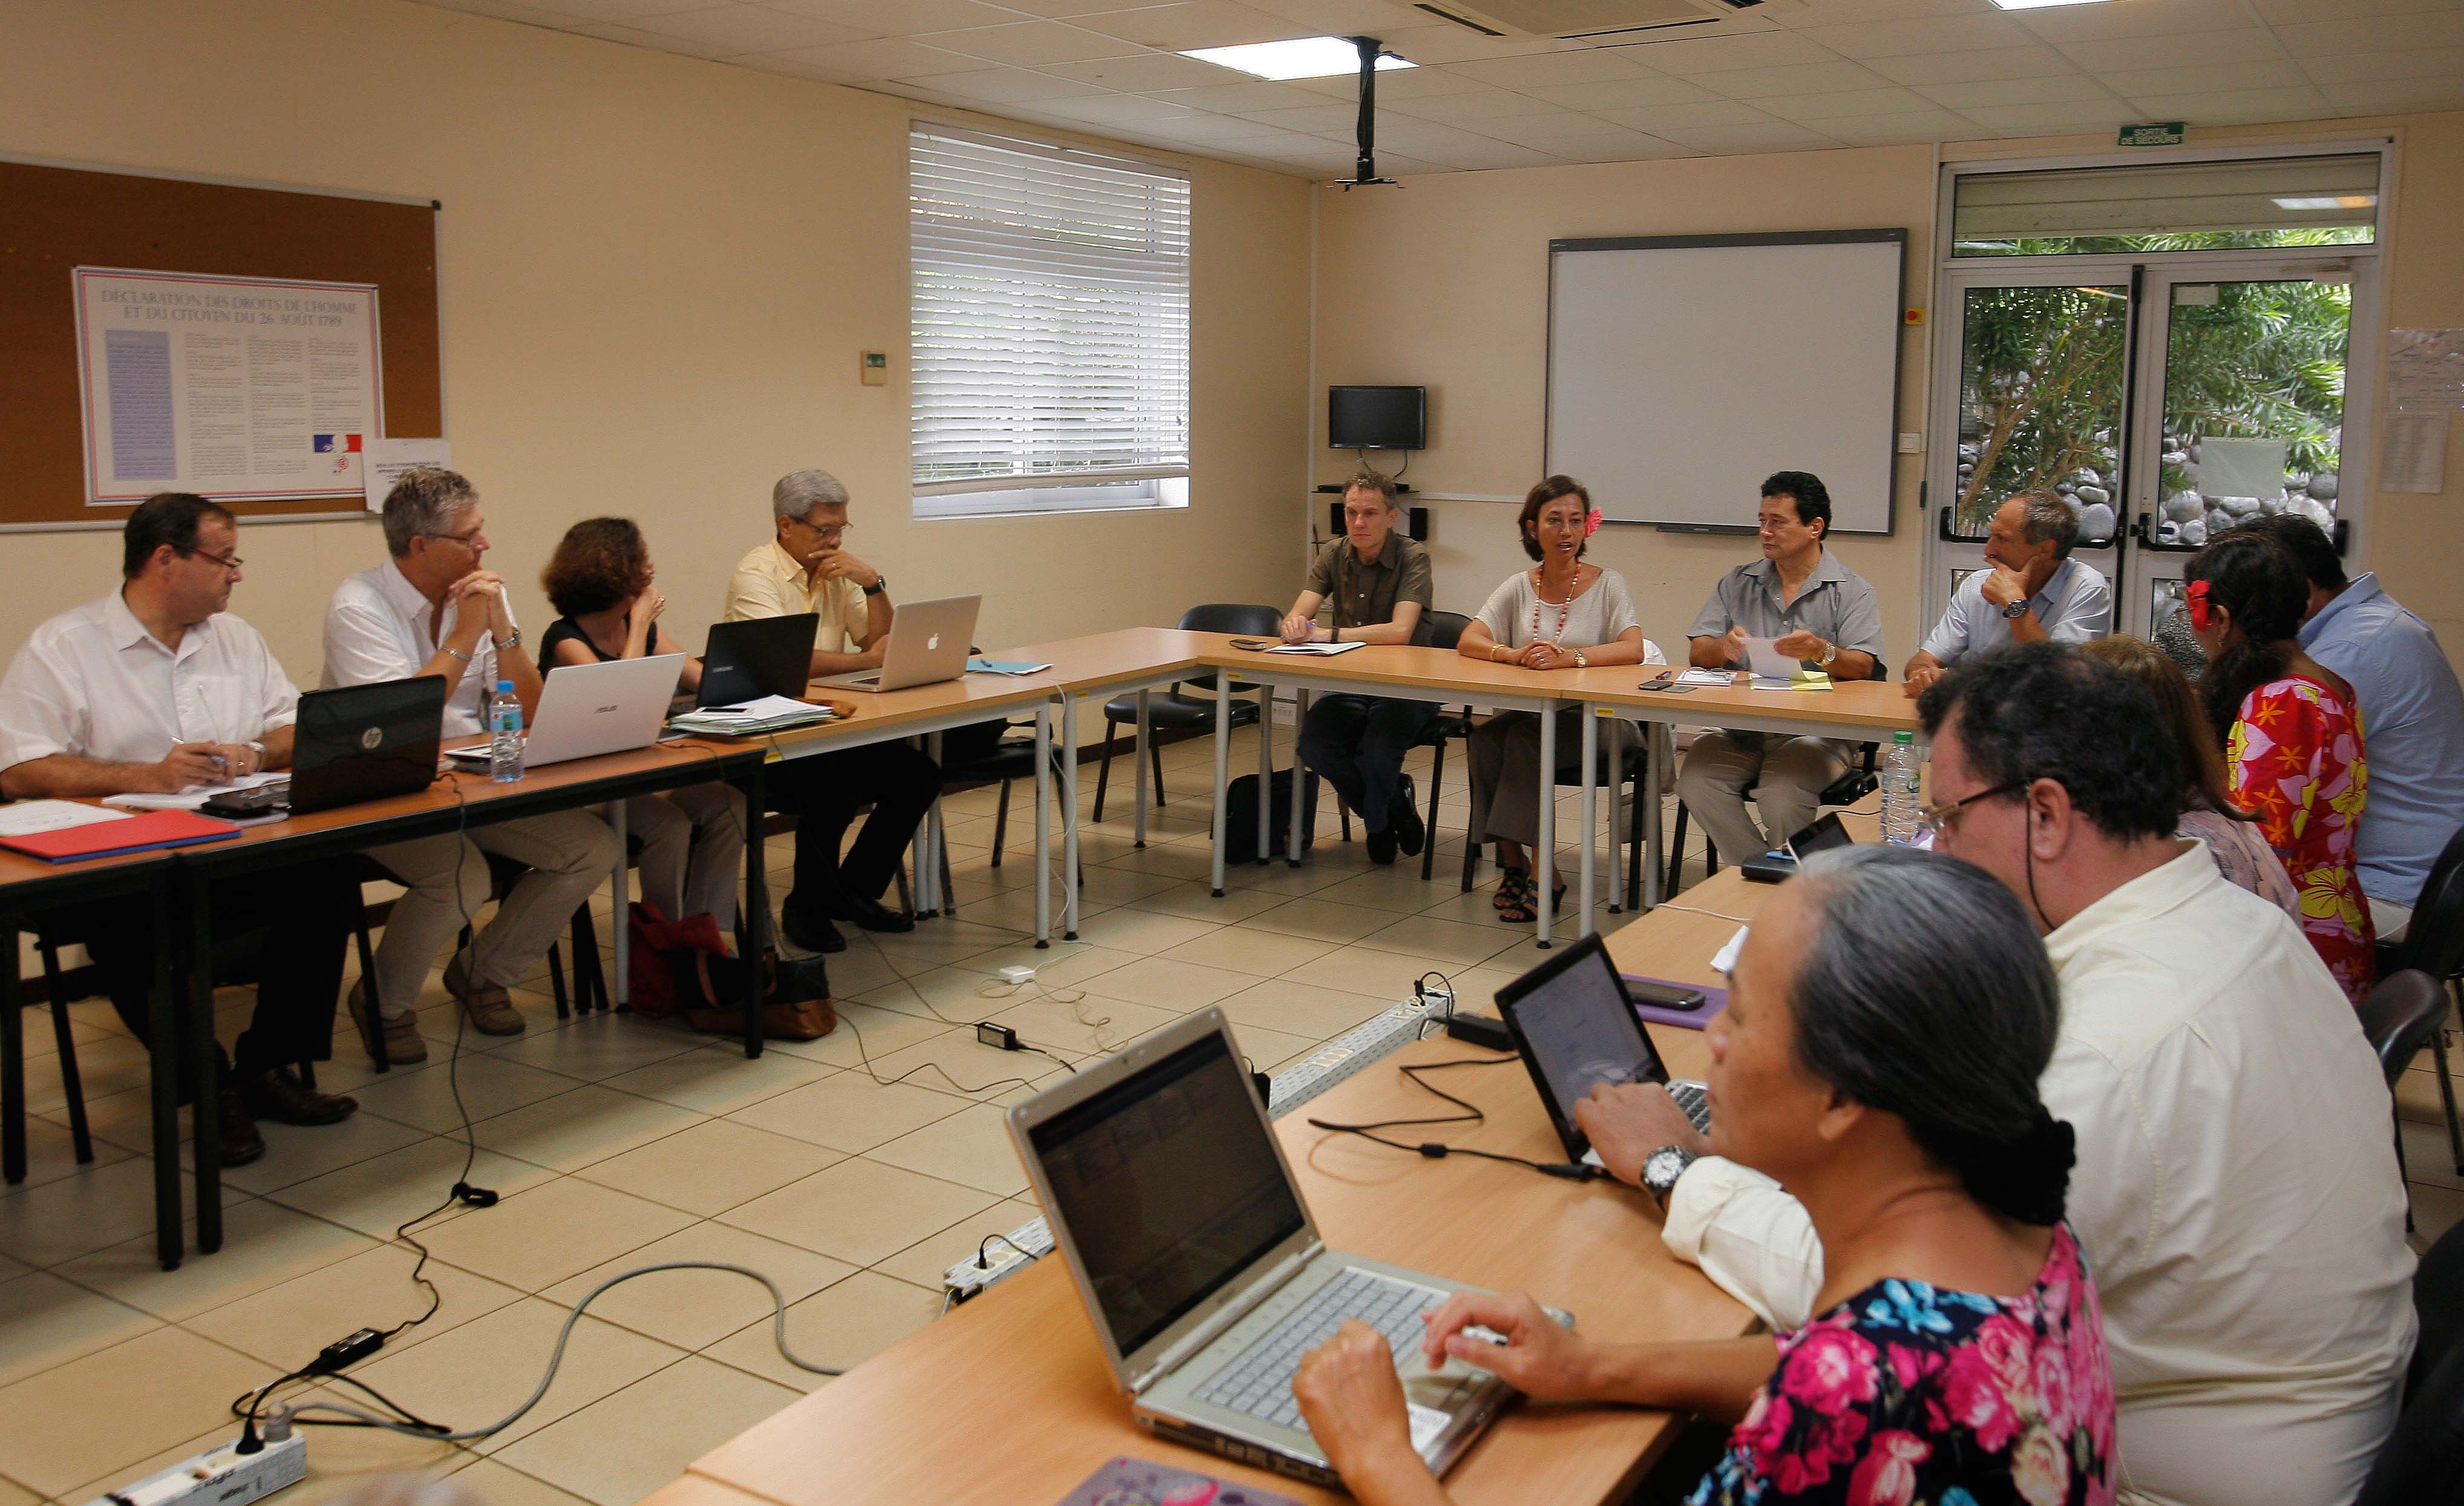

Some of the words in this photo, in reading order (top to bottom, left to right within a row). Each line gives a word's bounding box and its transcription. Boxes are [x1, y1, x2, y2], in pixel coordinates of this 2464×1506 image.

[2121, 137, 2134, 145] DE
[2134, 134, 2178, 145] SECOURS
[2134, 128, 2169, 136] SORTIE
[101, 289, 202, 306] DÉCLARATION
[205, 294, 229, 308] DES
[232, 297, 281, 311] DROITS
[284, 299, 300, 312] DE
[124, 305, 140, 319] ET
[146, 307, 168, 320] DU
[172, 308, 230, 323] CITOYEN
[234, 312, 254, 325] DU
[260, 312, 275, 325] 26
[280, 310, 313, 326] AOÛT
